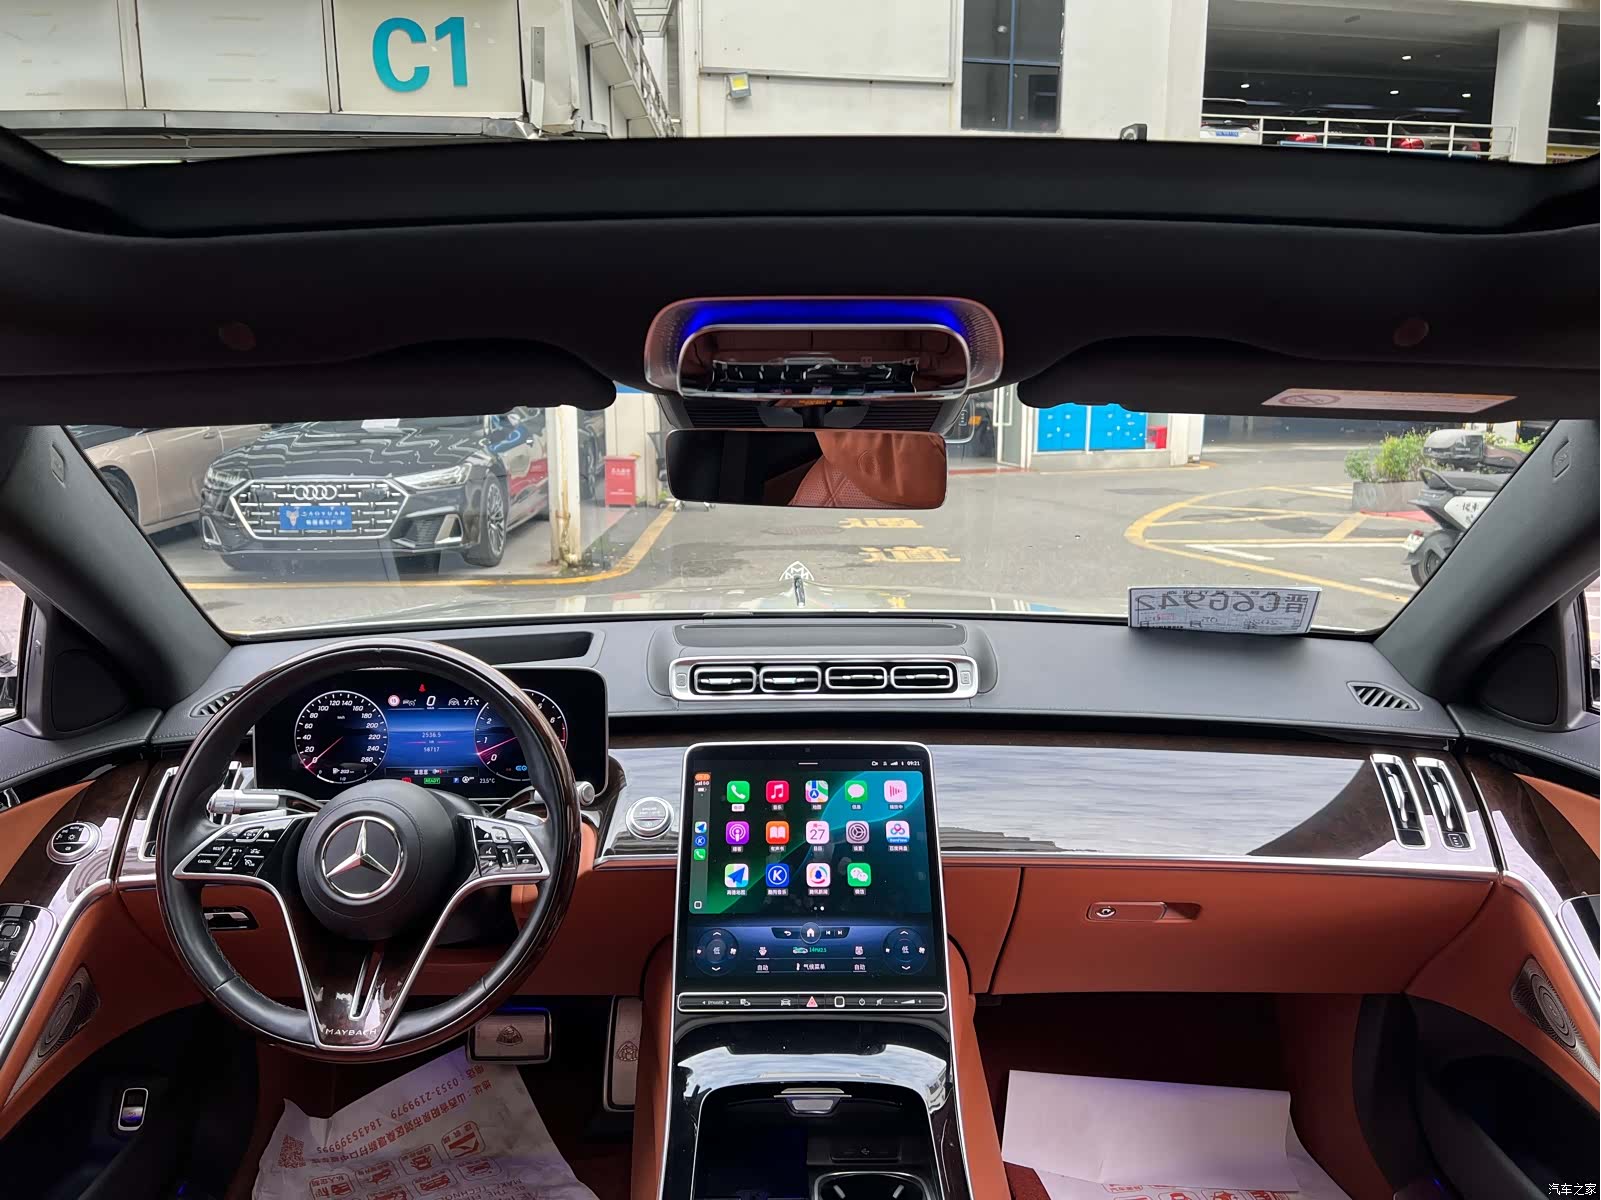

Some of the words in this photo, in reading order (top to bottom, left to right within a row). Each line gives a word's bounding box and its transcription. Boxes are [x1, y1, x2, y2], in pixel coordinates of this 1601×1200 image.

[372, 15, 469, 92] C1
[426, 695, 436, 706] 0
[809, 828, 825, 840] 27
[901, 945, 909, 954] 低
[854, 963, 865, 971] 自动
[325, 1028, 377, 1036] MAYBACH
